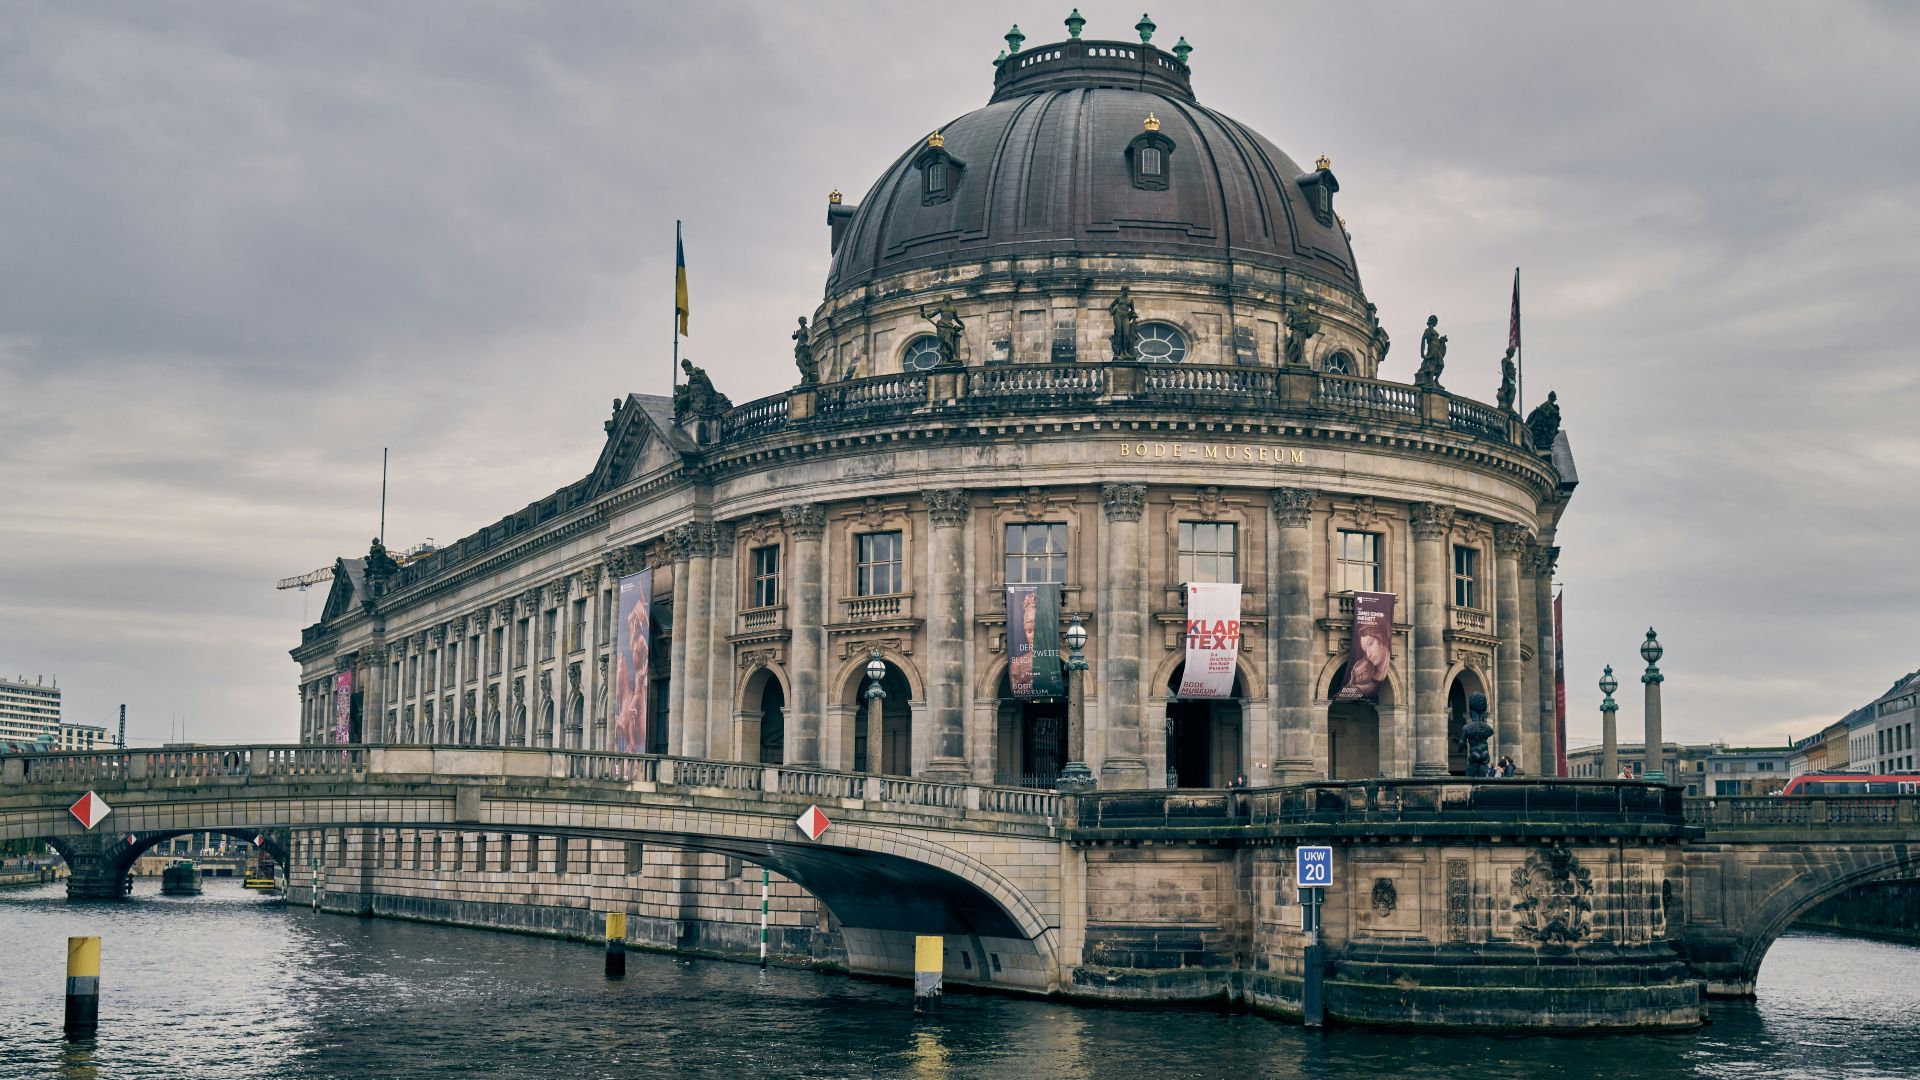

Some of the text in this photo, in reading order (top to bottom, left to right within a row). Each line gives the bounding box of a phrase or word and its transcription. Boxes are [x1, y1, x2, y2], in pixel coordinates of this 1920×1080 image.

[1120, 444, 1304, 463] BODE-MUSEUM
[1187, 620, 1239, 634] KLAR
[1187, 635, 1239, 649] TEXT
[1011, 656, 1032, 664] BLICK
[1181, 687, 1217, 695] MUSEUM
[1864, 782, 1870, 793] 1
[1304, 851, 1325, 861] UKW
[1305, 863, 1325, 881] 20
